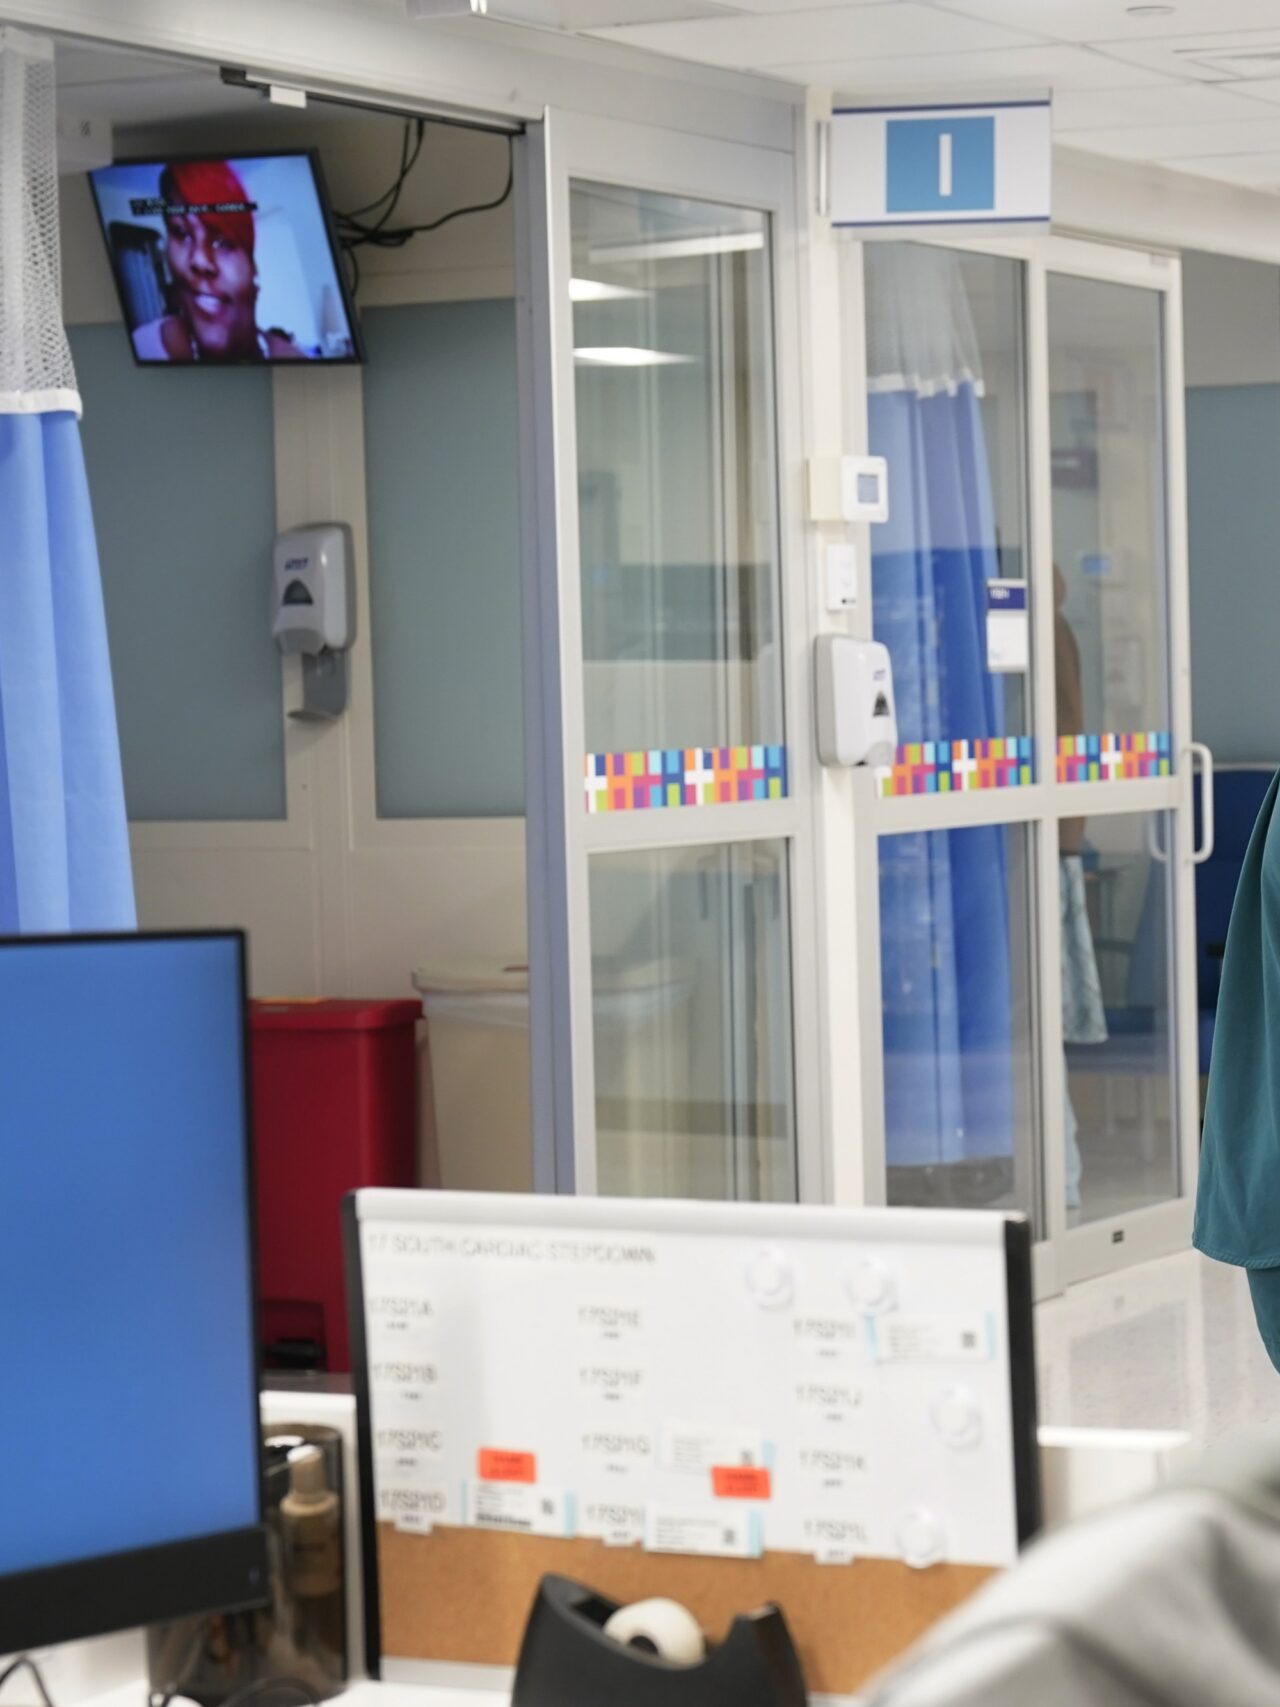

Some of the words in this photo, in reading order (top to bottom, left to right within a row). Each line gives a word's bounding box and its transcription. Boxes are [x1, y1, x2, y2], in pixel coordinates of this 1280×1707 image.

[940, 134, 951, 196] I
[393, 1234, 455, 1252] SOUTH
[461, 1237, 542, 1257] CARDIAC
[550, 1242, 655, 1262] STEPDOWN
